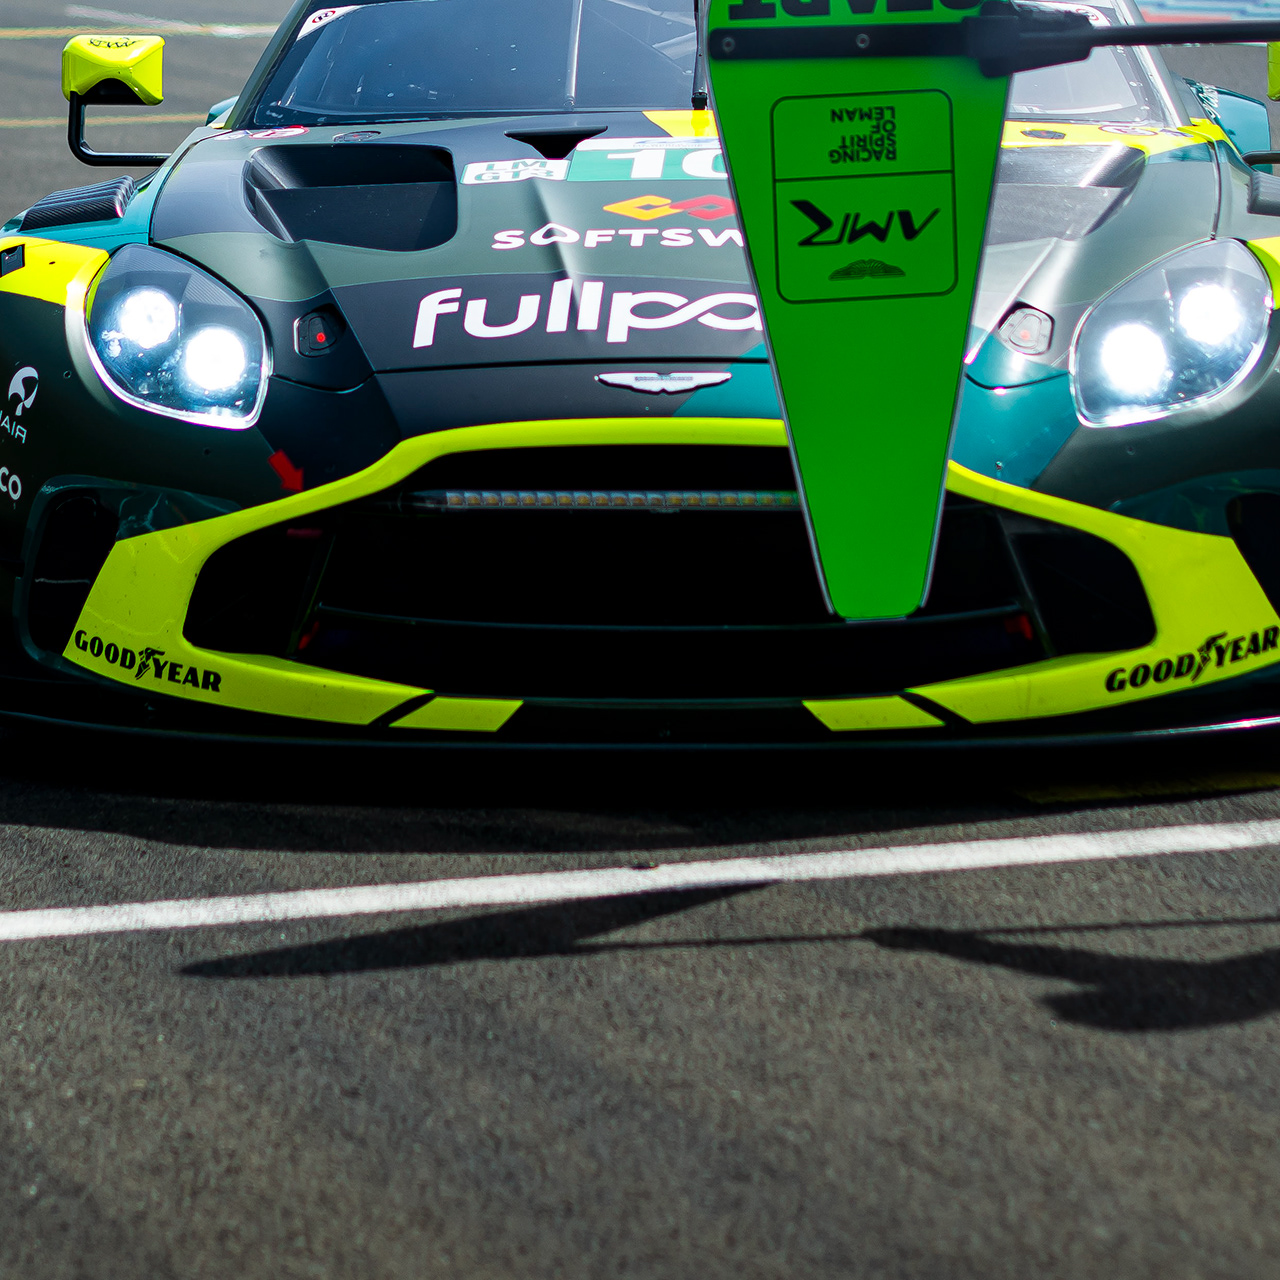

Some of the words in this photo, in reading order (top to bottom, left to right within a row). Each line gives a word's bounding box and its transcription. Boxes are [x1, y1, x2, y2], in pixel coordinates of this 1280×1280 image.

[871, 119, 896, 134] OF
[838, 132, 896, 149] SPIRIT
[828, 147, 897, 164] RACING
[486, 161, 548, 172] LM
[789, 200, 941, 247] AMR
[75, 629, 222, 693] GOODYEAR
[1105, 625, 1280, 694] GOODYEAR
